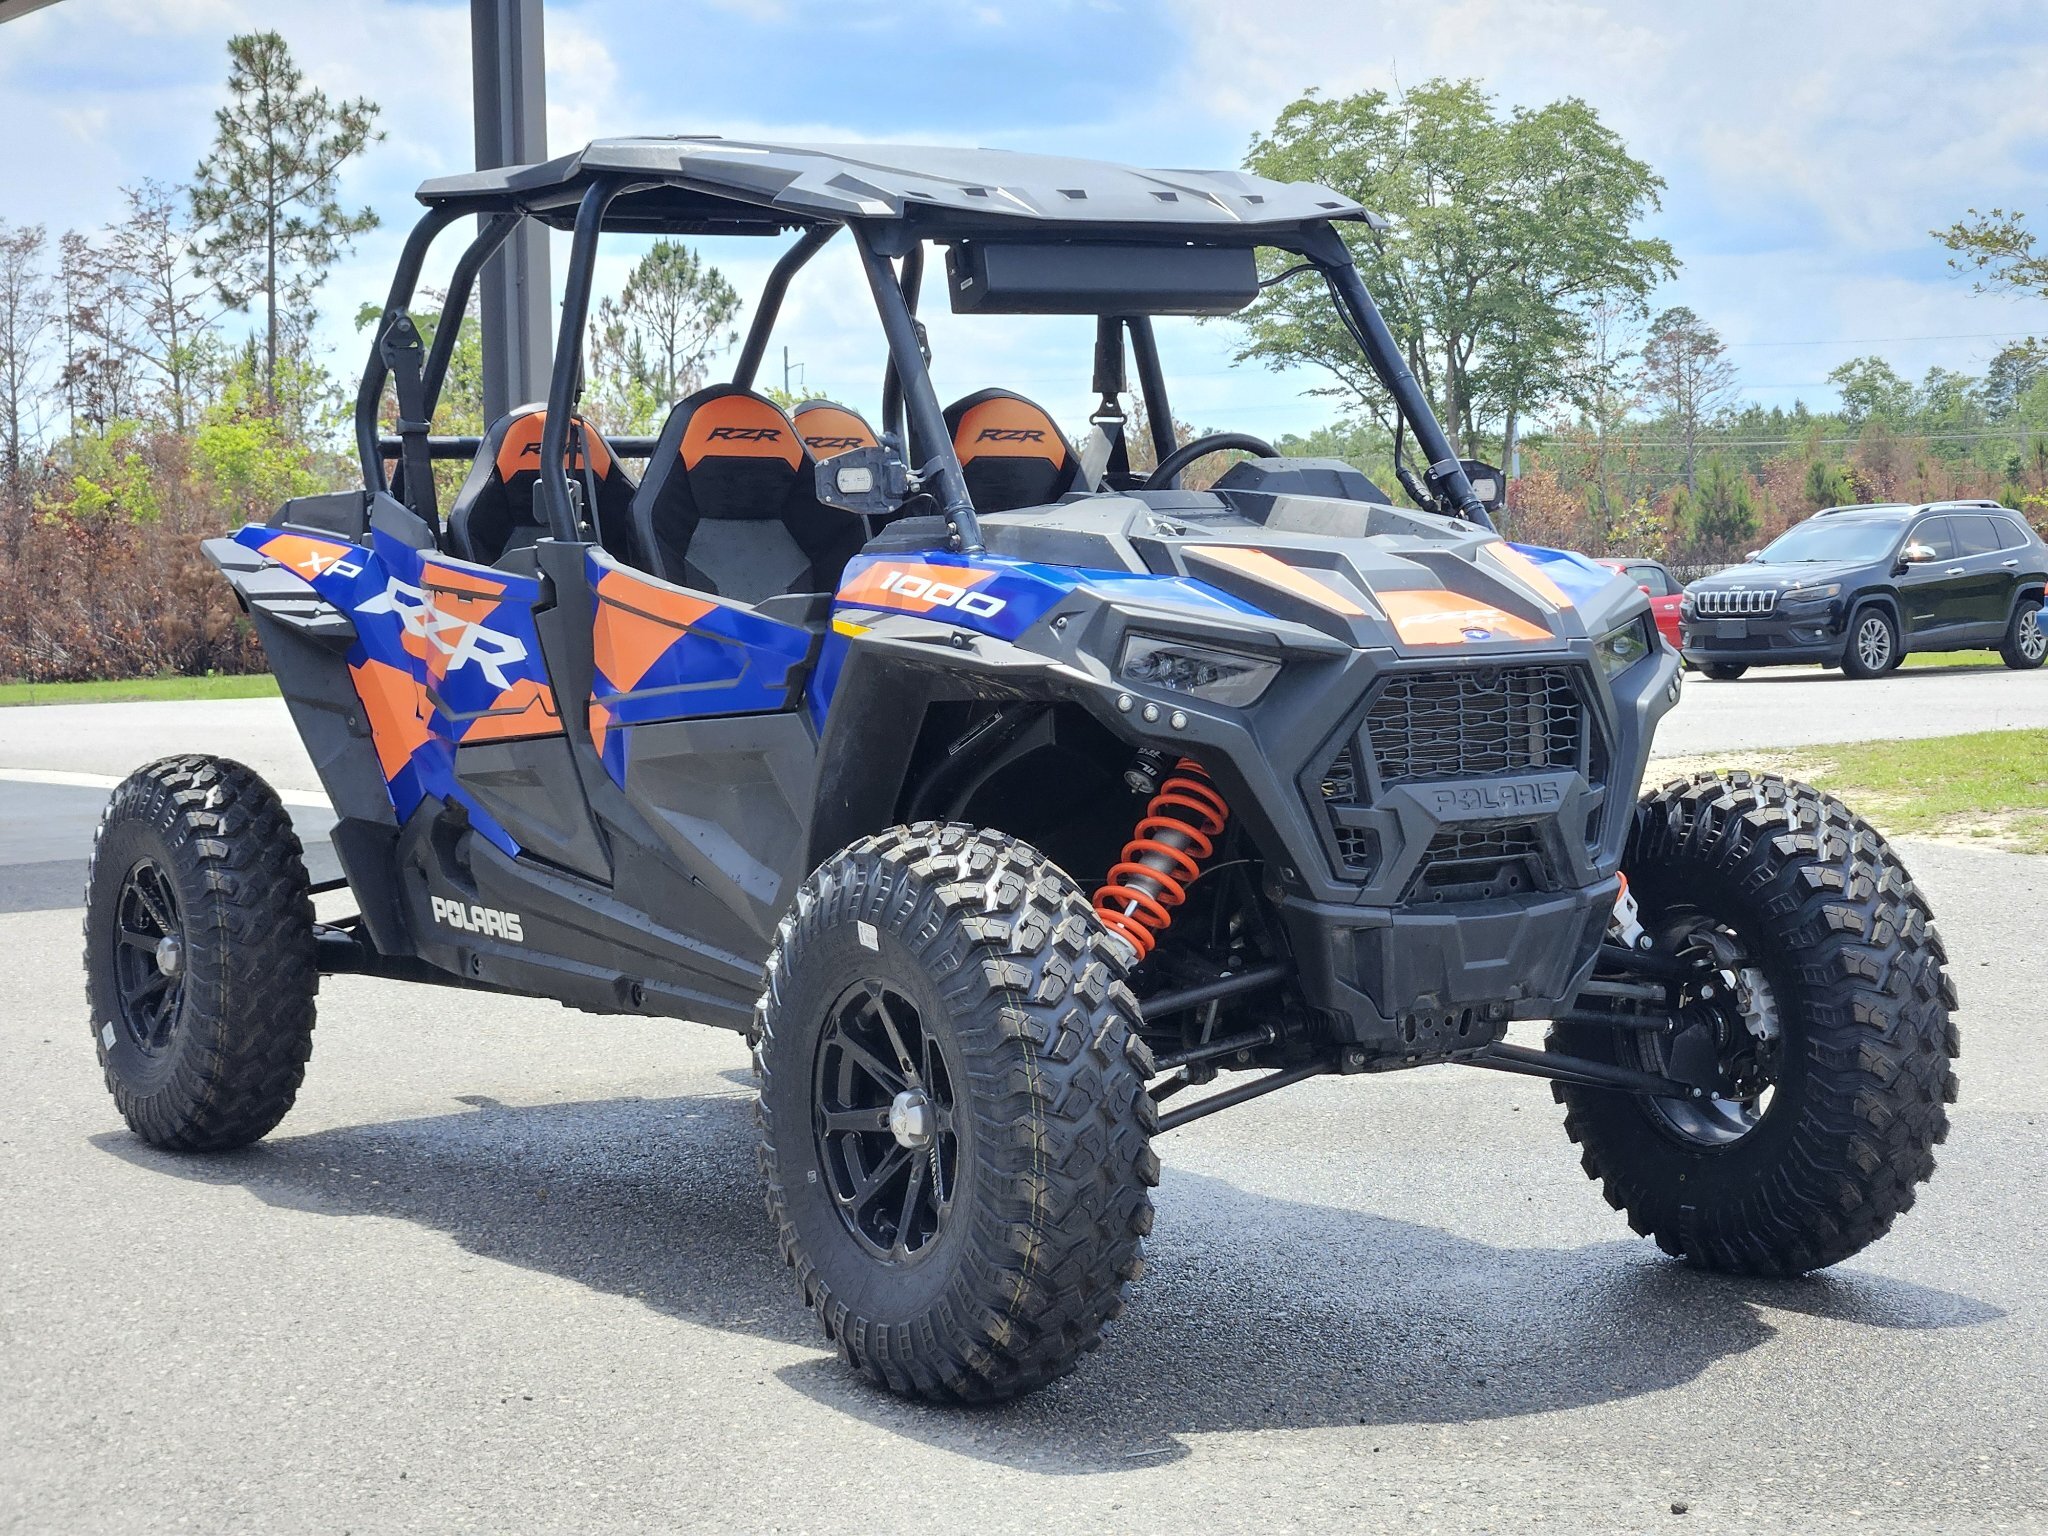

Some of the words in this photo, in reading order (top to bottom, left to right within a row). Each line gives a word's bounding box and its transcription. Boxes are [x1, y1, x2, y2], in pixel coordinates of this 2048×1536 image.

[706, 427, 782, 442] RZR
[803, 436, 865, 449] RZR
[975, 428, 1047, 443] RZR
[297, 551, 364, 579] XP
[879, 570, 1007, 619] 1000
[353, 575, 529, 692] RZR
[1431, 780, 1561, 813] POLARIS
[430, 895, 524, 943] POLARIS
